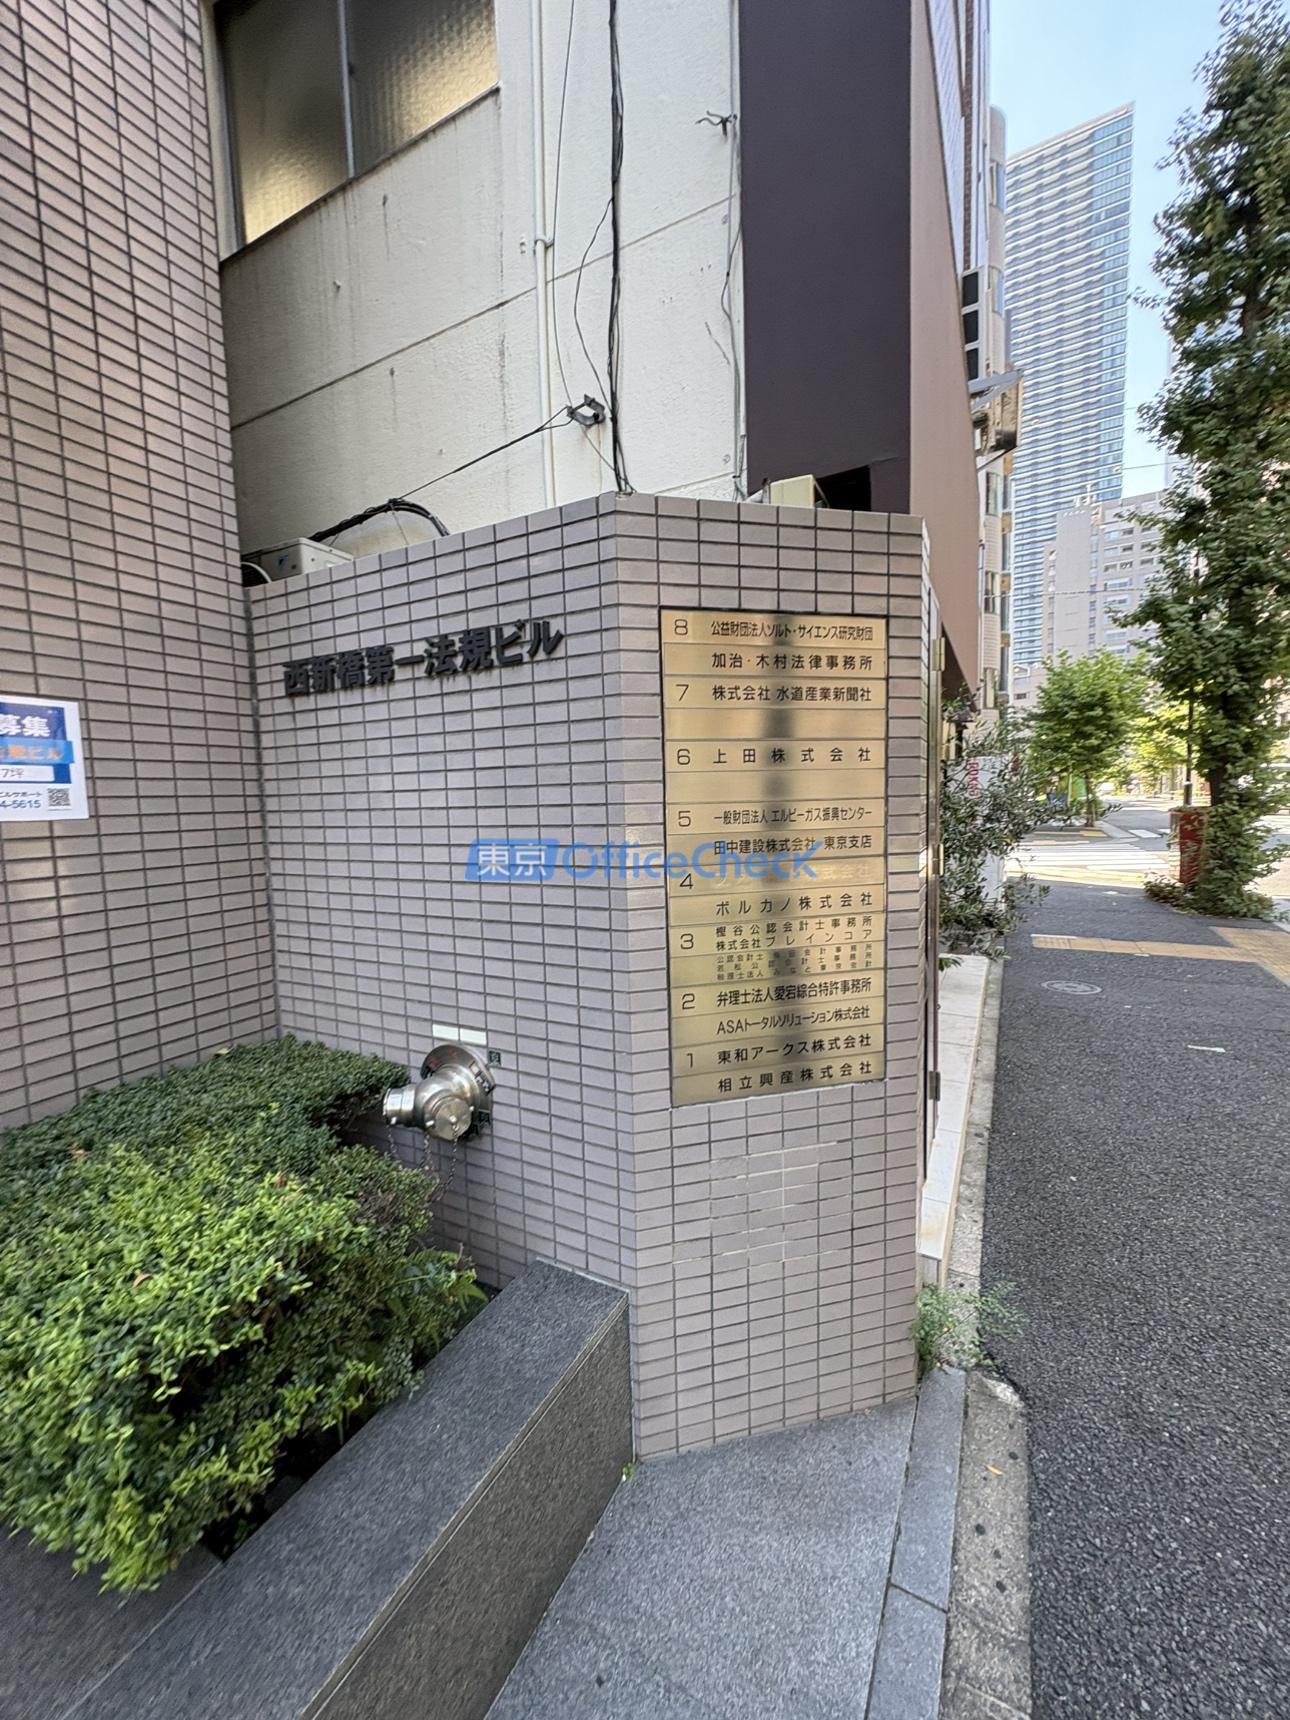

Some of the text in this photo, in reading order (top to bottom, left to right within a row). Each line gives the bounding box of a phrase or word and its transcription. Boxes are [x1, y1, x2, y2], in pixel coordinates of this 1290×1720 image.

[674, 618, 689, 636] 8
[284, 619, 564, 697] 西新橋第一法規ビル
[676, 684, 689, 701] 7
[677, 747, 872, 766] 6 上田株式会社
[678, 810, 691, 827] 5
[680, 873, 694, 890] 4
[680, 933, 694, 950] 3
[682, 992, 695, 1010] 2
[686, 1033, 872, 1068] 1 東和アークス株式会社
[718, 1061, 872, 1093] 相立興産株式会社
